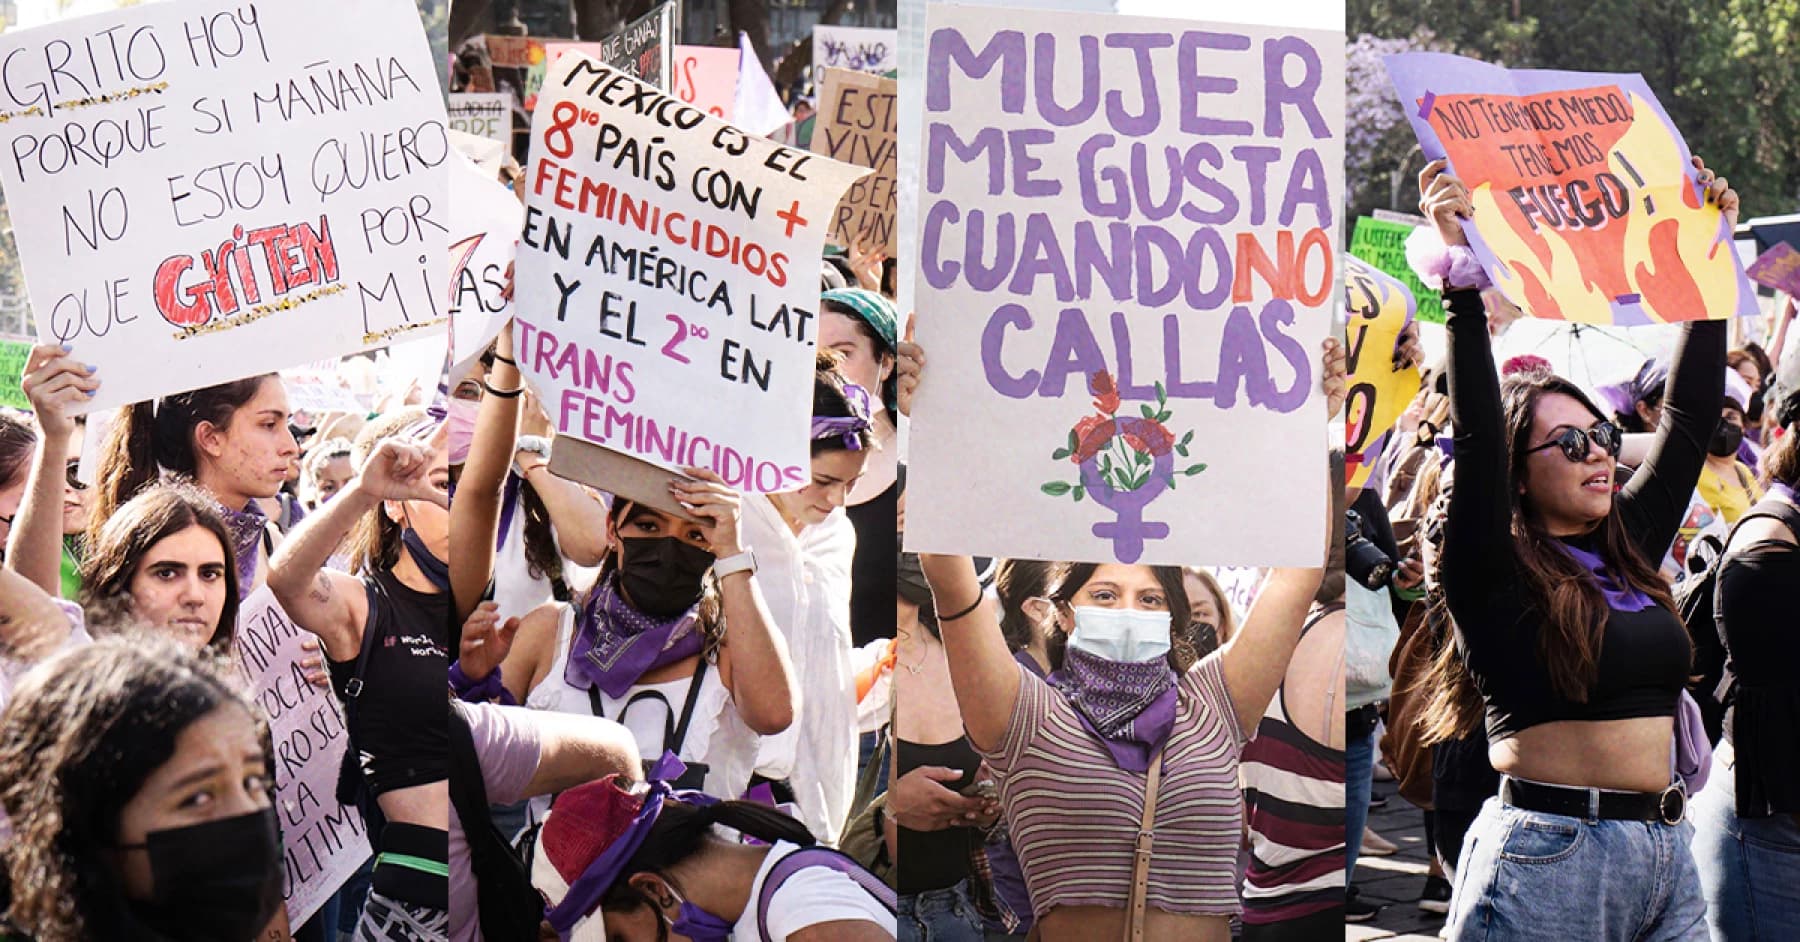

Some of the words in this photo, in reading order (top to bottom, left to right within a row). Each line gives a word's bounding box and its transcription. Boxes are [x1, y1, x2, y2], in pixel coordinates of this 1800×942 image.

[2, 25, 167, 118] GRITO
[184, 4, 270, 69] HOY
[836, 89, 897, 132] EST
[926, 28, 1332, 139] MUJER
[12, 106, 167, 182] PORQUE
[193, 98, 234, 134] SI
[253, 57, 421, 123] MAÑANA
[563, 59, 706, 130] MEXICO
[712, 125, 749, 157] ES
[764, 147, 809, 181] EL
[595, 123, 676, 192] PAÍS
[692, 166, 762, 220] CON
[1434, 100, 1480, 140] NO
[1469, 97, 1566, 134] TENEMOS
[63, 187, 129, 256] NO
[168, 154, 291, 227] ESTOY
[311, 120, 448, 202] QUIERO
[533, 158, 789, 288] FEMINICIDIOS
[927, 122, 1062, 198] ME
[1077, 133, 1332, 230] GUSTA
[51, 278, 138, 346] QUE
[360, 195, 449, 253] POR
[522, 205, 573, 260] EN
[585, 235, 734, 316] AMÉRICA
[750, 294, 816, 347] LAT.
[921, 200, 1233, 310] CUANDO
[1232, 227, 1333, 307] NO
[515, 317, 636, 403] TRANS
[553, 272, 580, 321] Y
[600, 290, 646, 347] EL
[720, 337, 771, 392] EN
[980, 299, 1312, 413] CALLAS
[558, 389, 806, 493] FEMINICIDIOS
[282, 803, 366, 900] ULTIM
